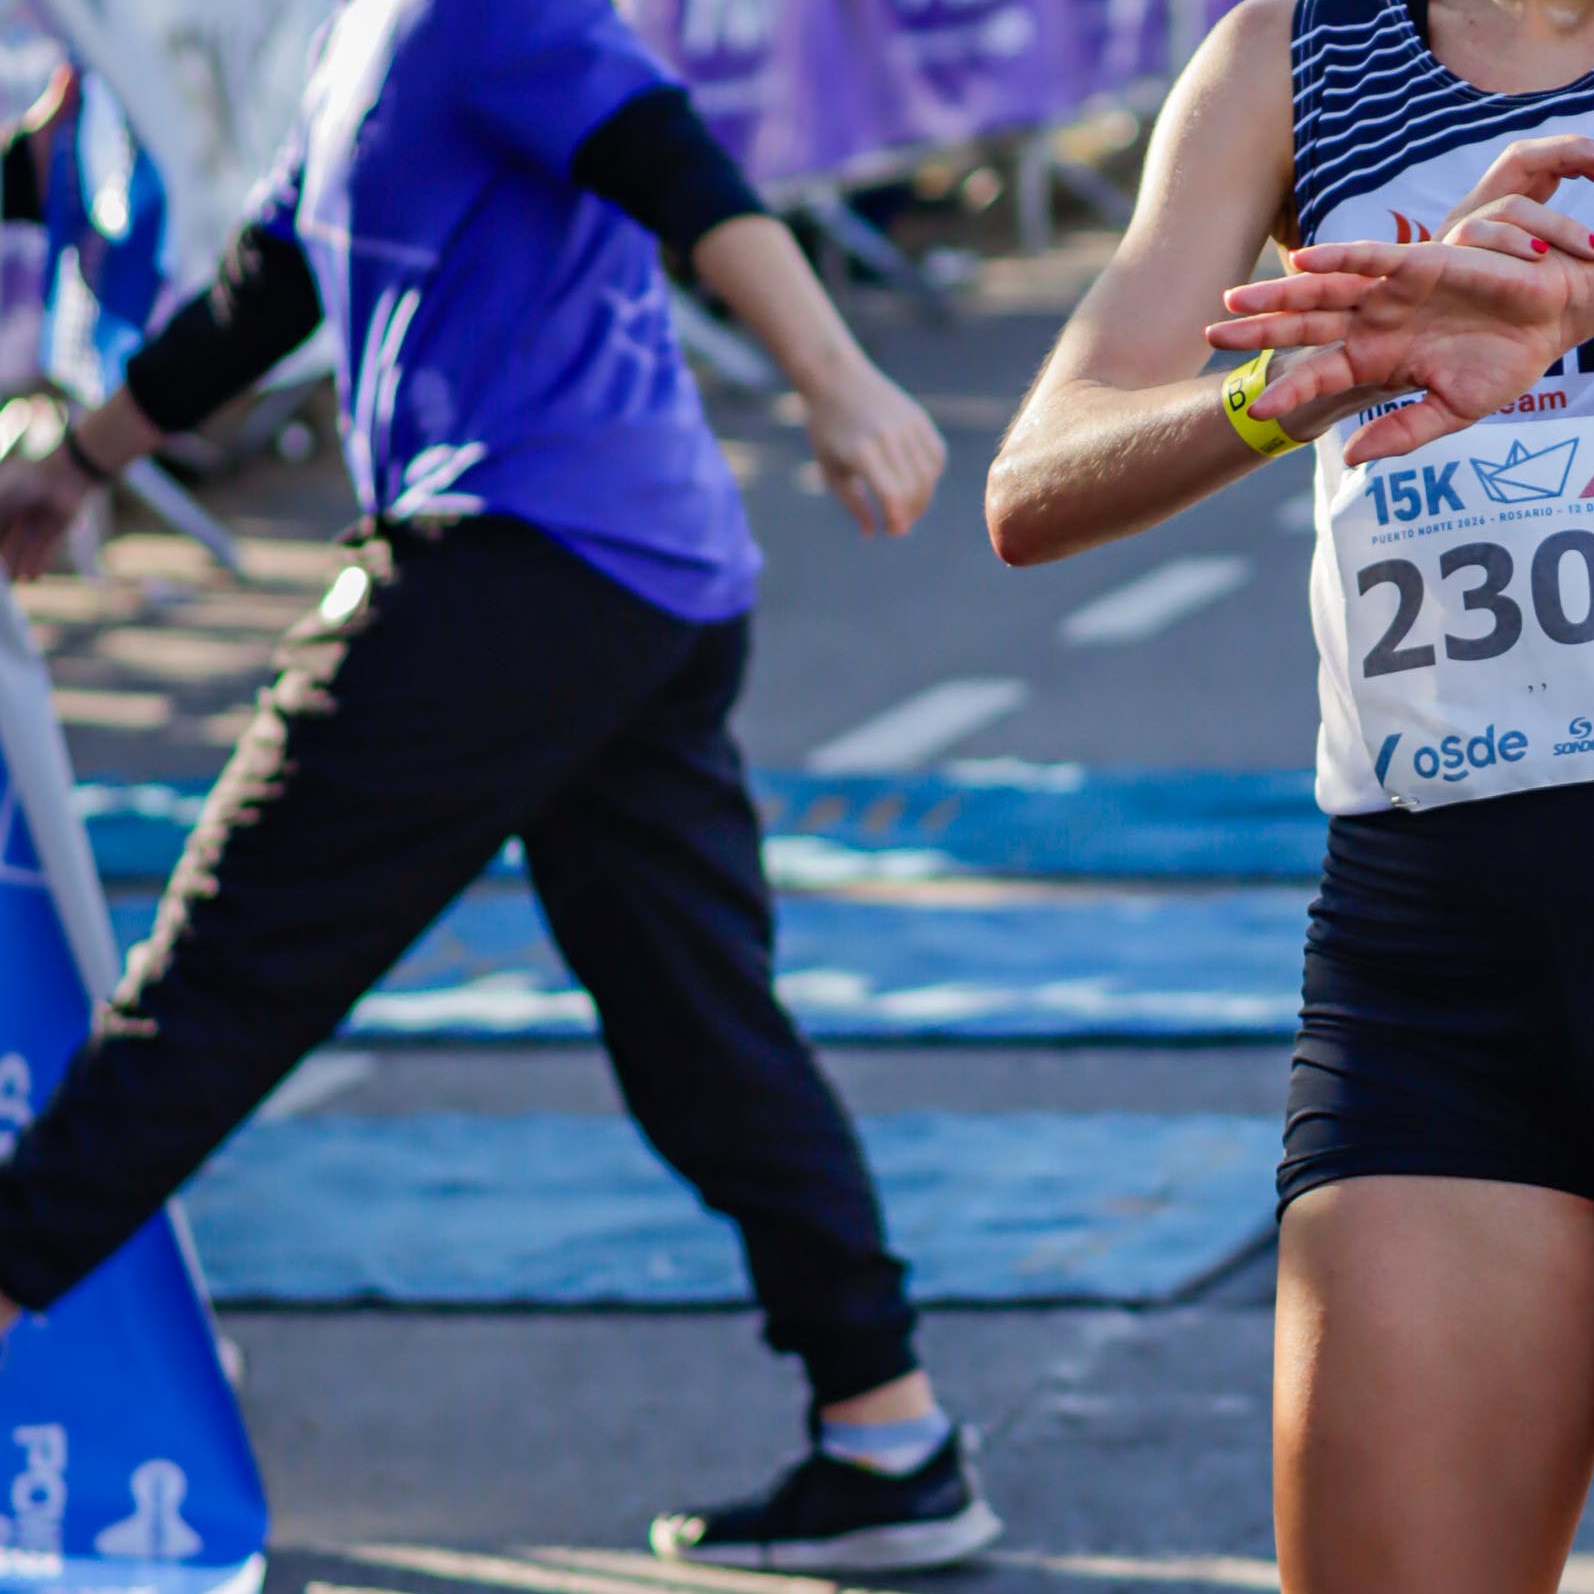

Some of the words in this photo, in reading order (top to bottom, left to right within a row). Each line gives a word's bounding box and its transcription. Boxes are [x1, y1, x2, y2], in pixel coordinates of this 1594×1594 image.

[1359, 389, 1427, 425] runn
[1491, 390, 1567, 416] eam
[1365, 461, 1466, 526] 15K
[1371, 528, 1415, 545] PUERTO
[1418, 519, 1453, 537] NORTE
[1458, 515, 1486, 529] 2026
[1499, 506, 1553, 522] ROSARIO
[1413, 724, 1529, 781] osde
